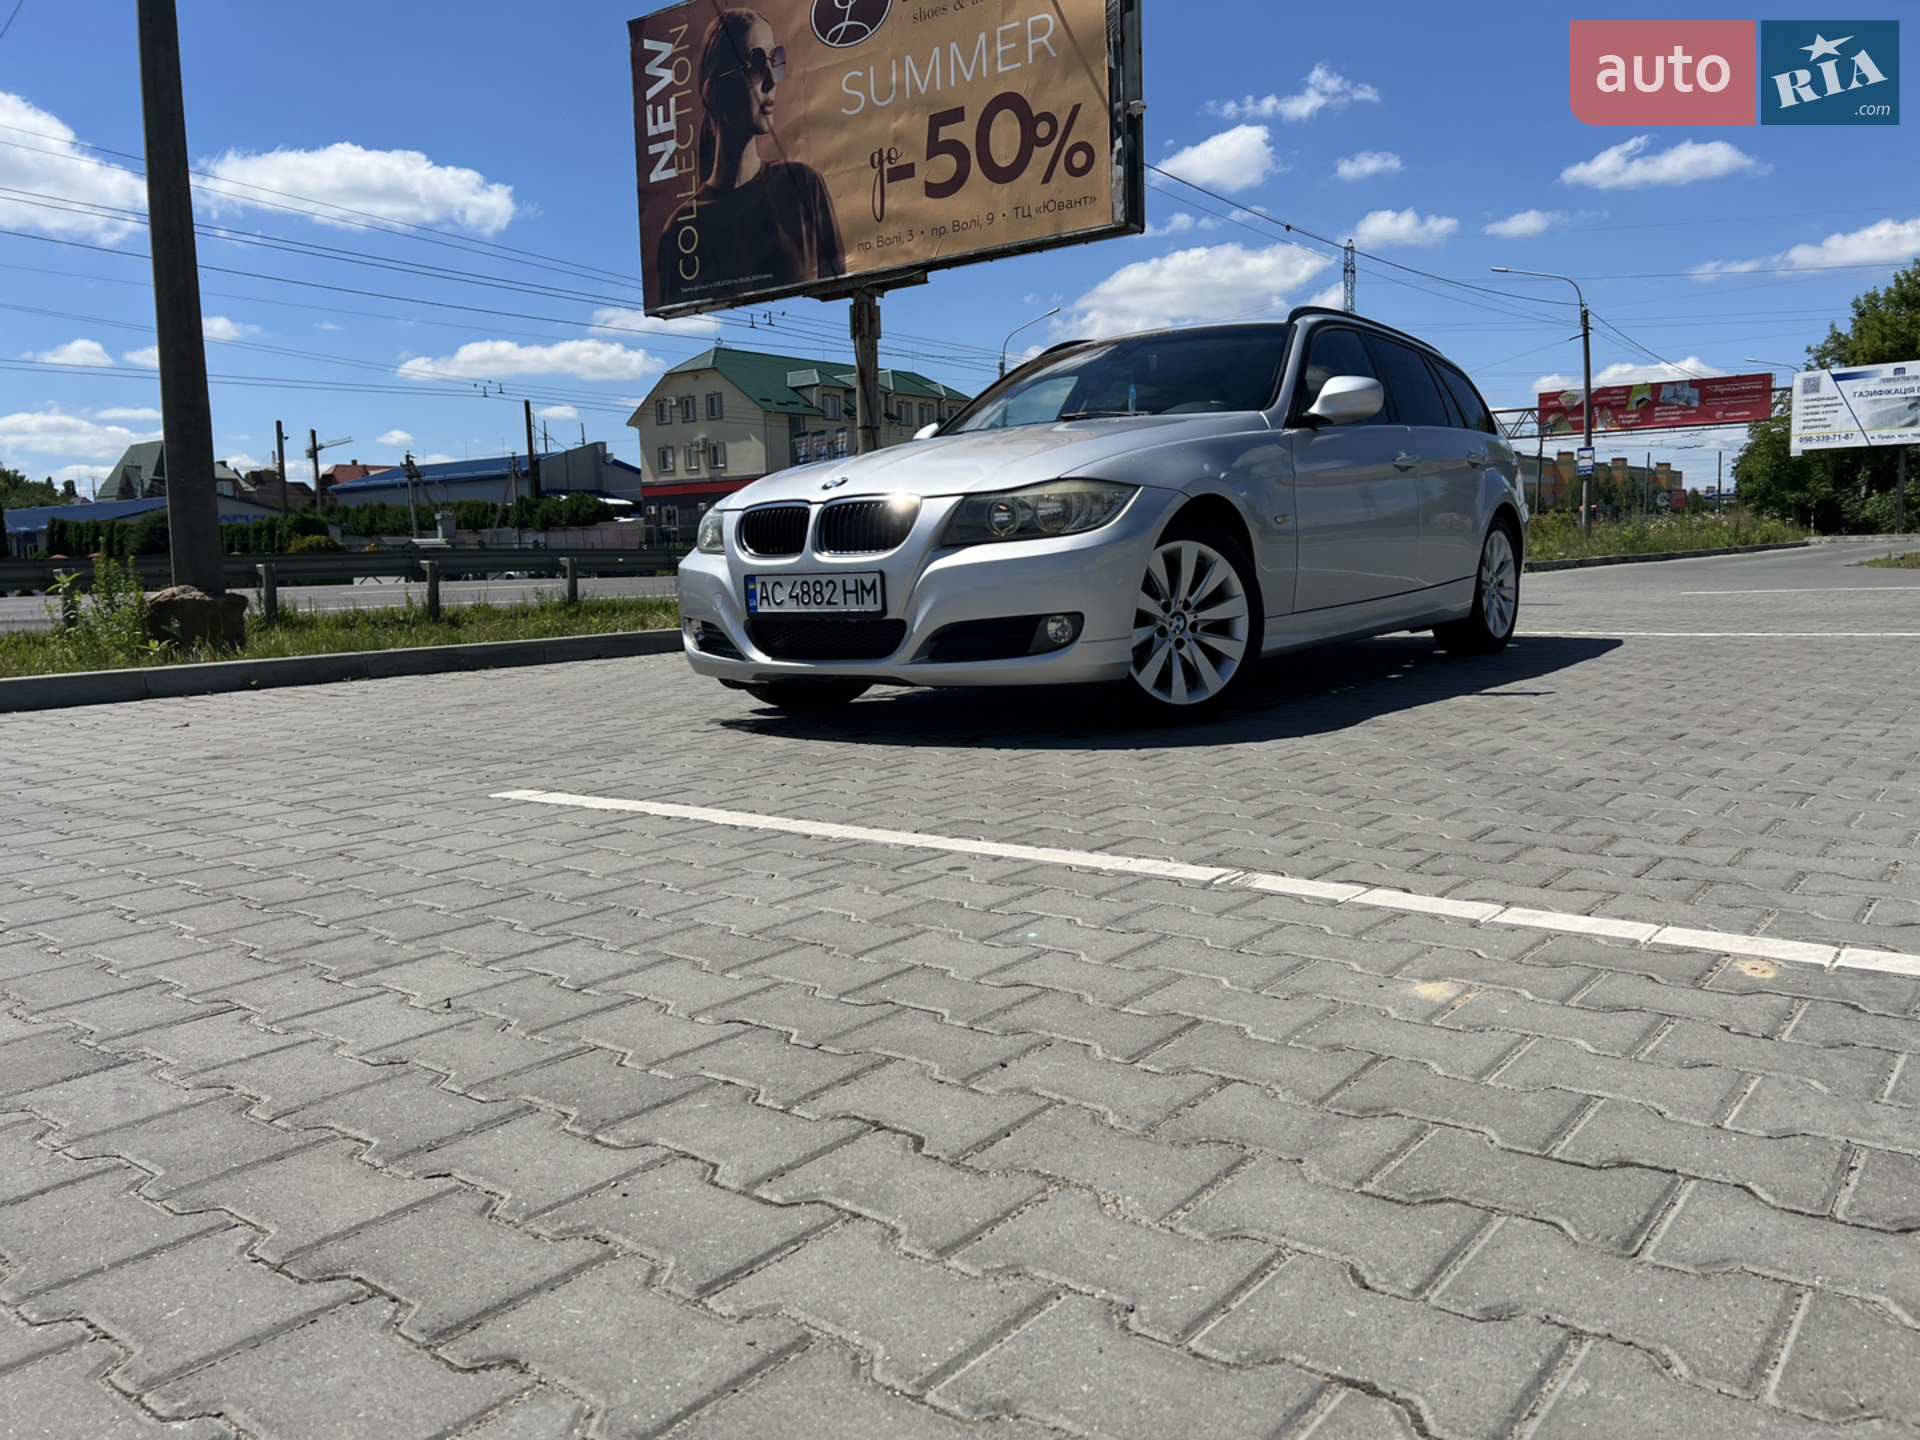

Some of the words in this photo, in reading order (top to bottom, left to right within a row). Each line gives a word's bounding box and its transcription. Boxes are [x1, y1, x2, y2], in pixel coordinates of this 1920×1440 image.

[912, 4, 948, 24] shoes
[953, 0, 965, 11] &
[841, 13, 1057, 115] SUMMER
[643, 39, 679, 183] NEW
[669, 24, 700, 281] COLLECTION
[886, 91, 1096, 199] -50%
[857, 240, 874, 253] пр.
[877, 231, 905, 248] Волі,
[907, 229, 914, 242] 3
[931, 225, 949, 238] пр.
[952, 216, 983, 232] Волі,
[986, 212, 995, 225] 9
[1013, 204, 1032, 220] ТЦ
[1035, 195, 1097, 215] «Ювант»
[1853, 386, 1916, 398] ГАЗИФІКАЦІЯ
[1799, 433, 1855, 443] 050-339-71-87
[760, 581, 784, 606] AC
[789, 580, 838, 606] 4882
[842, 578, 878, 606] HM
